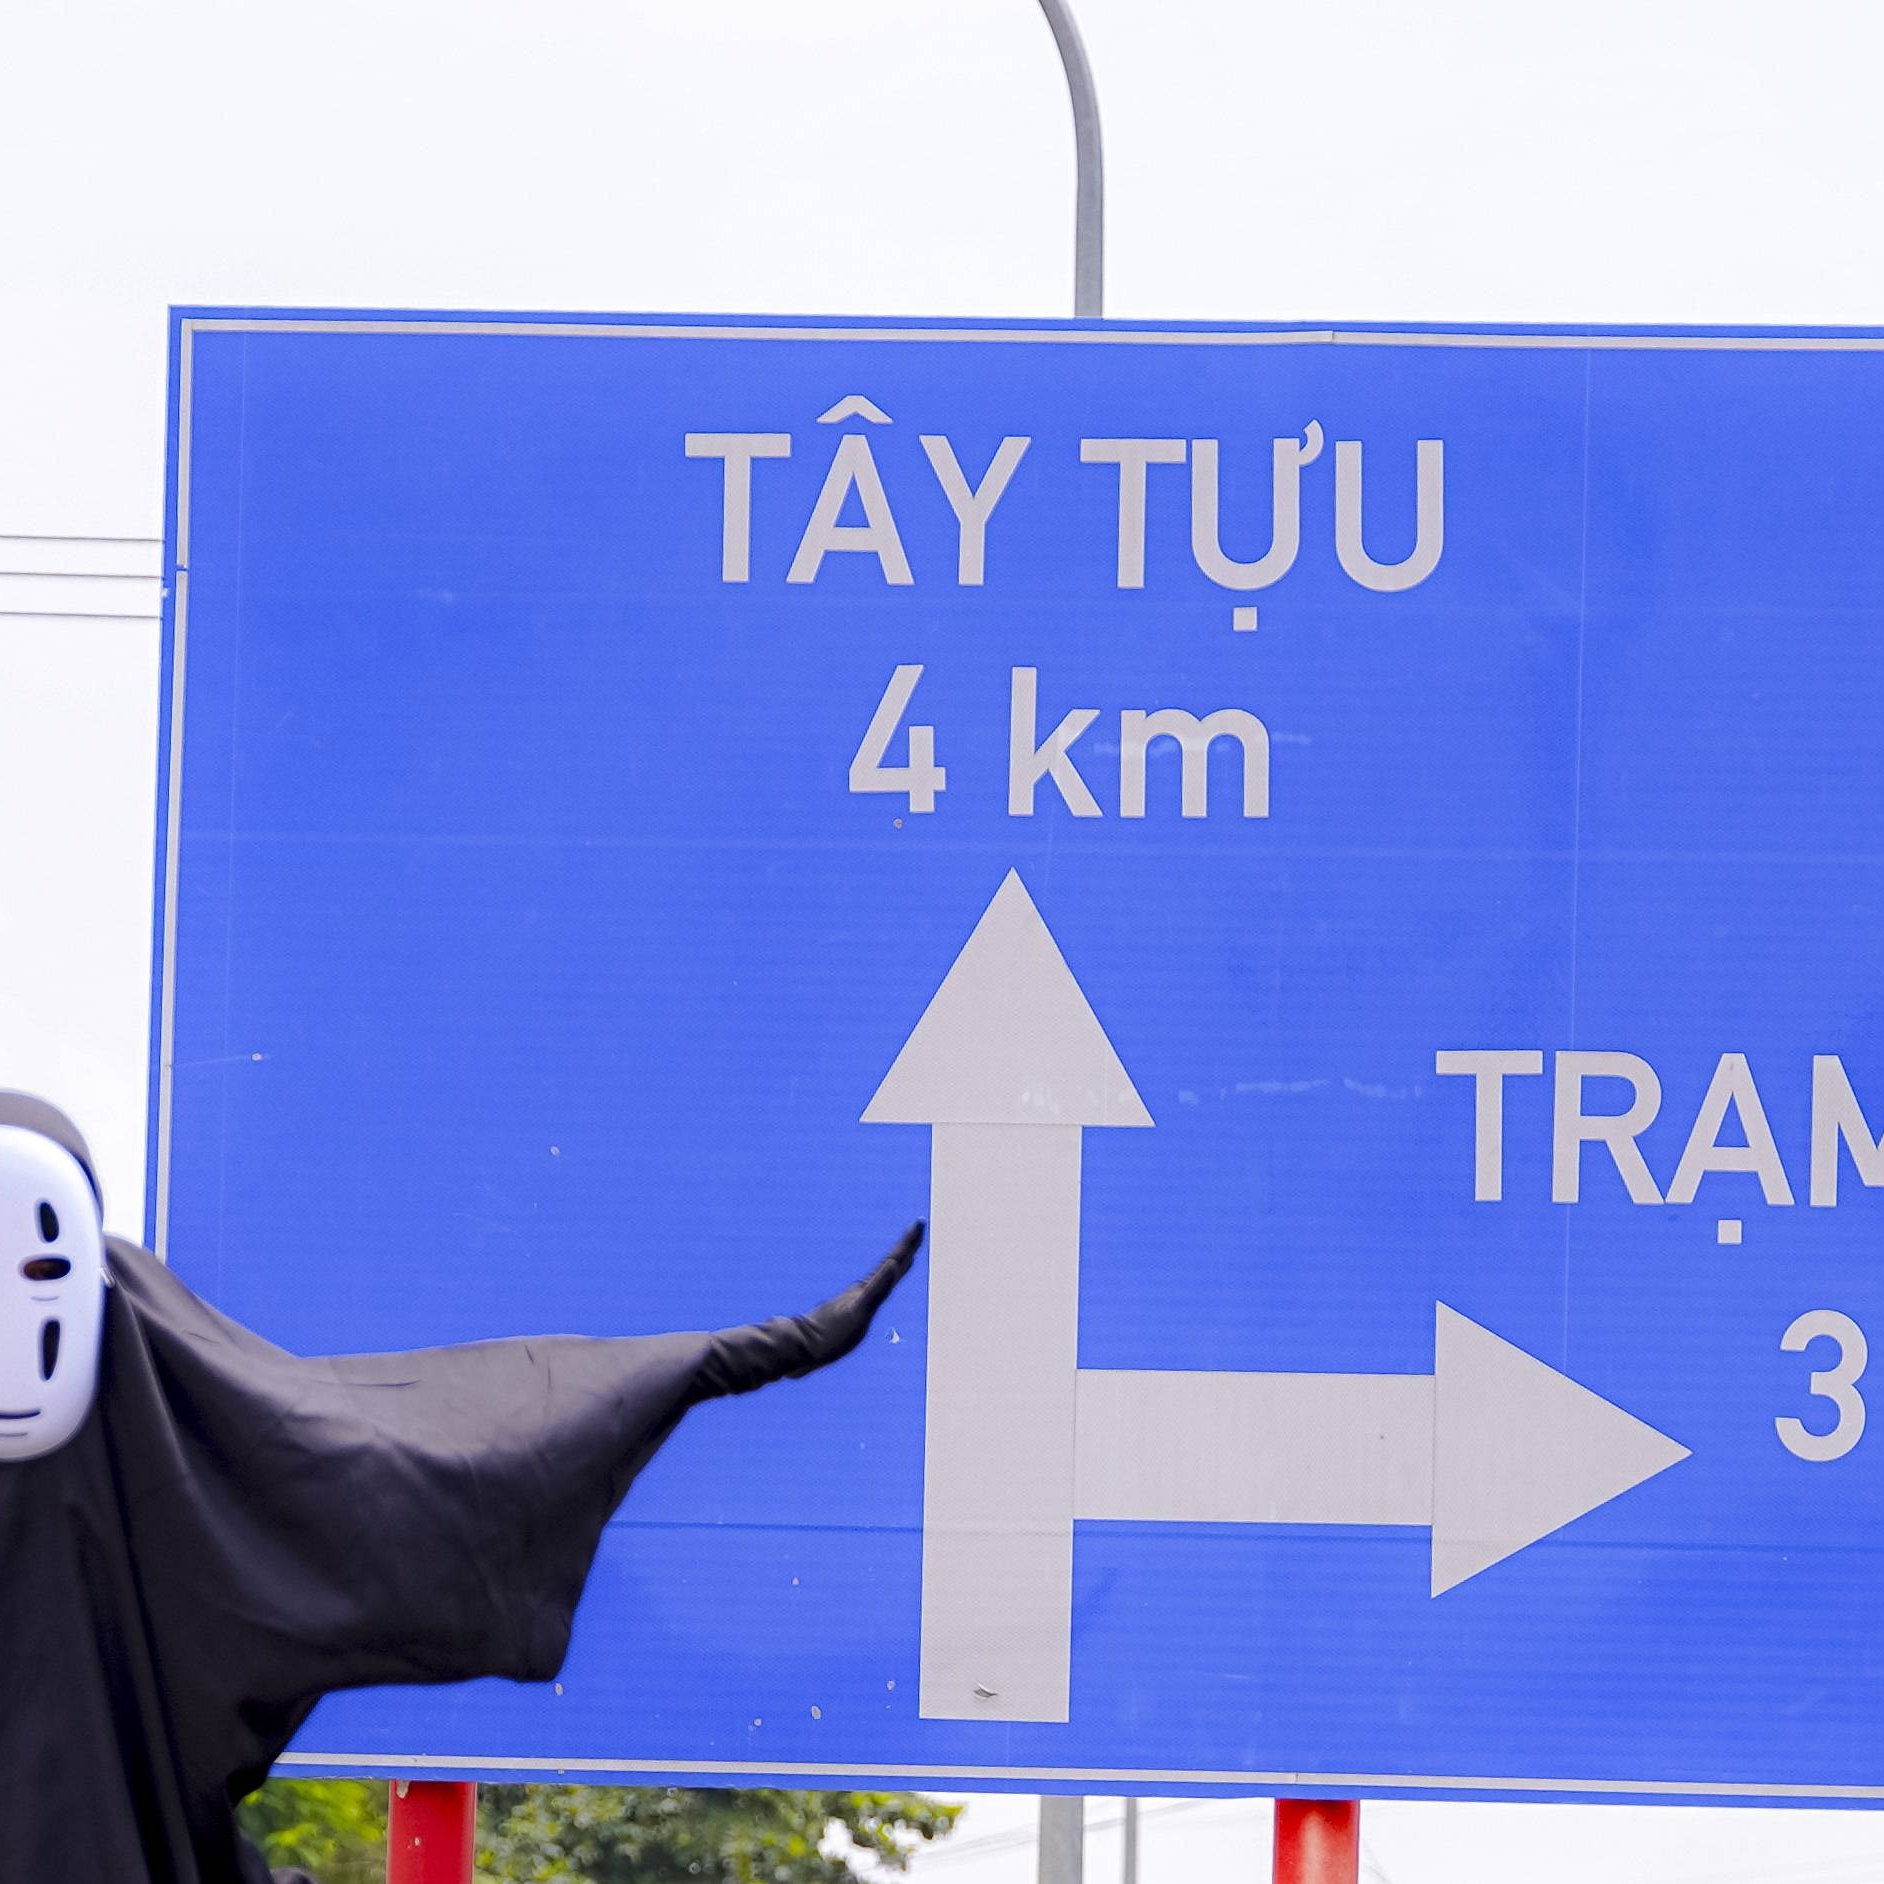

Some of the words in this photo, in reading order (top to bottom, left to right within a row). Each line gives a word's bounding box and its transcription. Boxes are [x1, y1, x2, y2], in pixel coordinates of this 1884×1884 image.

[683, 394, 1033, 587] TÂY
[1078, 418, 1445, 633] TỰU
[847, 663, 948, 815] 4
[1007, 665, 1272, 819] km
[1774, 1308, 1869, 1463] 3
